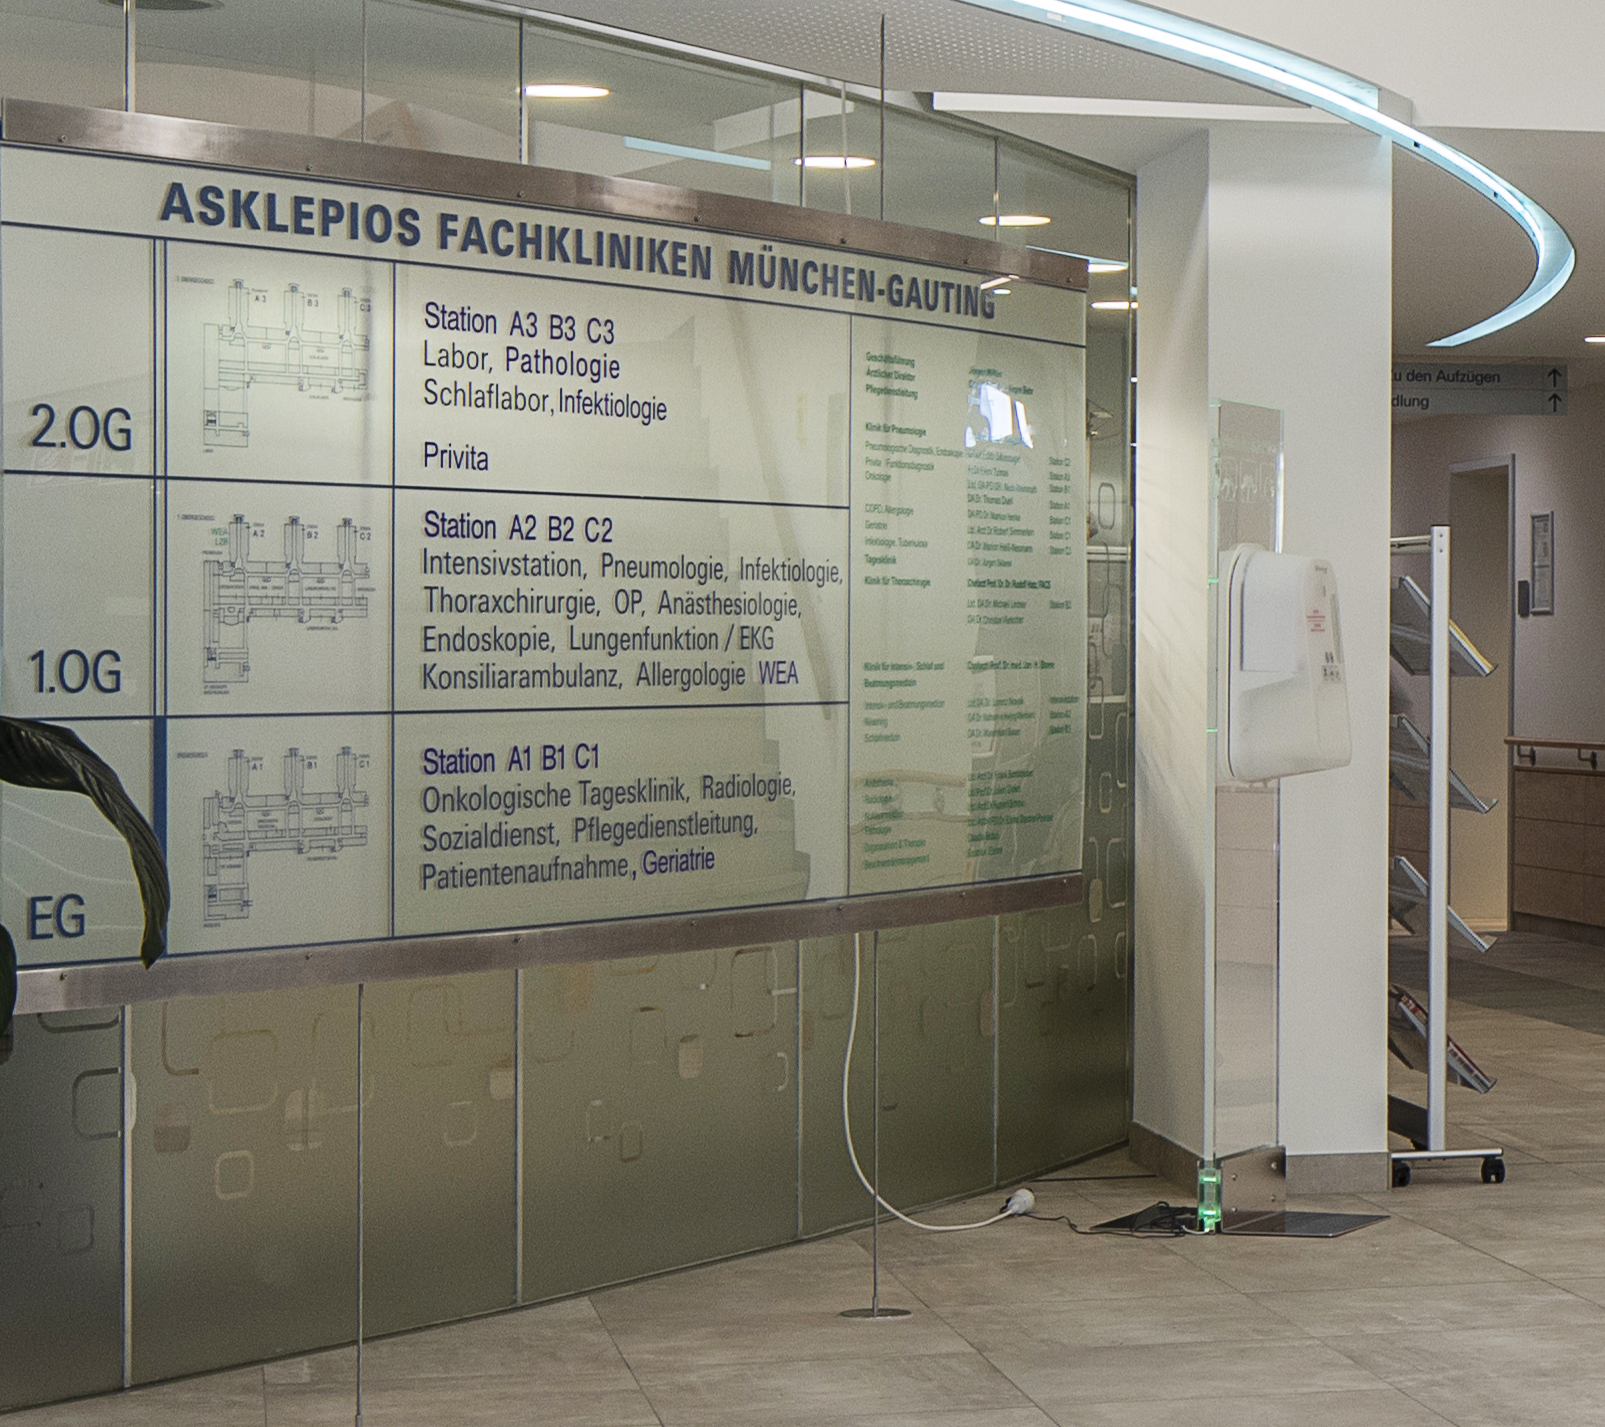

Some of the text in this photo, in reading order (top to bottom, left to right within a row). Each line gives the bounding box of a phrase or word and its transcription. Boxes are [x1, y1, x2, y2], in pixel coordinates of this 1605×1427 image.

[161, 182, 995, 320] ASKLEPIOS FACHKLINIKEN MÜNCHEN-GAUTING
[425, 302, 614, 344] Station A3 B3 C3
[424, 340, 619, 383] Labor, Pathologie
[1406, 369, 1432, 382] den
[1436, 369, 1501, 386] Aufzügen
[424, 378, 667, 426] Schlaflabor, Infektiologie
[28, 404, 131, 451] 2.OG
[425, 442, 488, 470] Privita
[424, 510, 612, 542] Station A2 B2 C2
[424, 548, 842, 588] Intensivstation, Pneumologie, Infektiologie,
[424, 586, 801, 621] Thoraxchirurgie, OP, Anästhesiologie,
[423, 625, 555, 657] Endoskopie,
[570, 625, 718, 657] Lungenfunktion
[737, 626, 773, 650] EKG
[28, 649, 120, 693] 1.OG
[423, 661, 798, 692] Konsiliarambulanz, Allergologie WEA
[424, 743, 598, 775] Station A1 B1 C1
[423, 773, 795, 816] Onkologische Tagesklinik, Radiologie,
[423, 813, 758, 854] Sozialdienst, Pflegedienstleitung,
[422, 850, 715, 892] Patientenaufnahme, Geriatrie
[26, 894, 84, 940] EG
